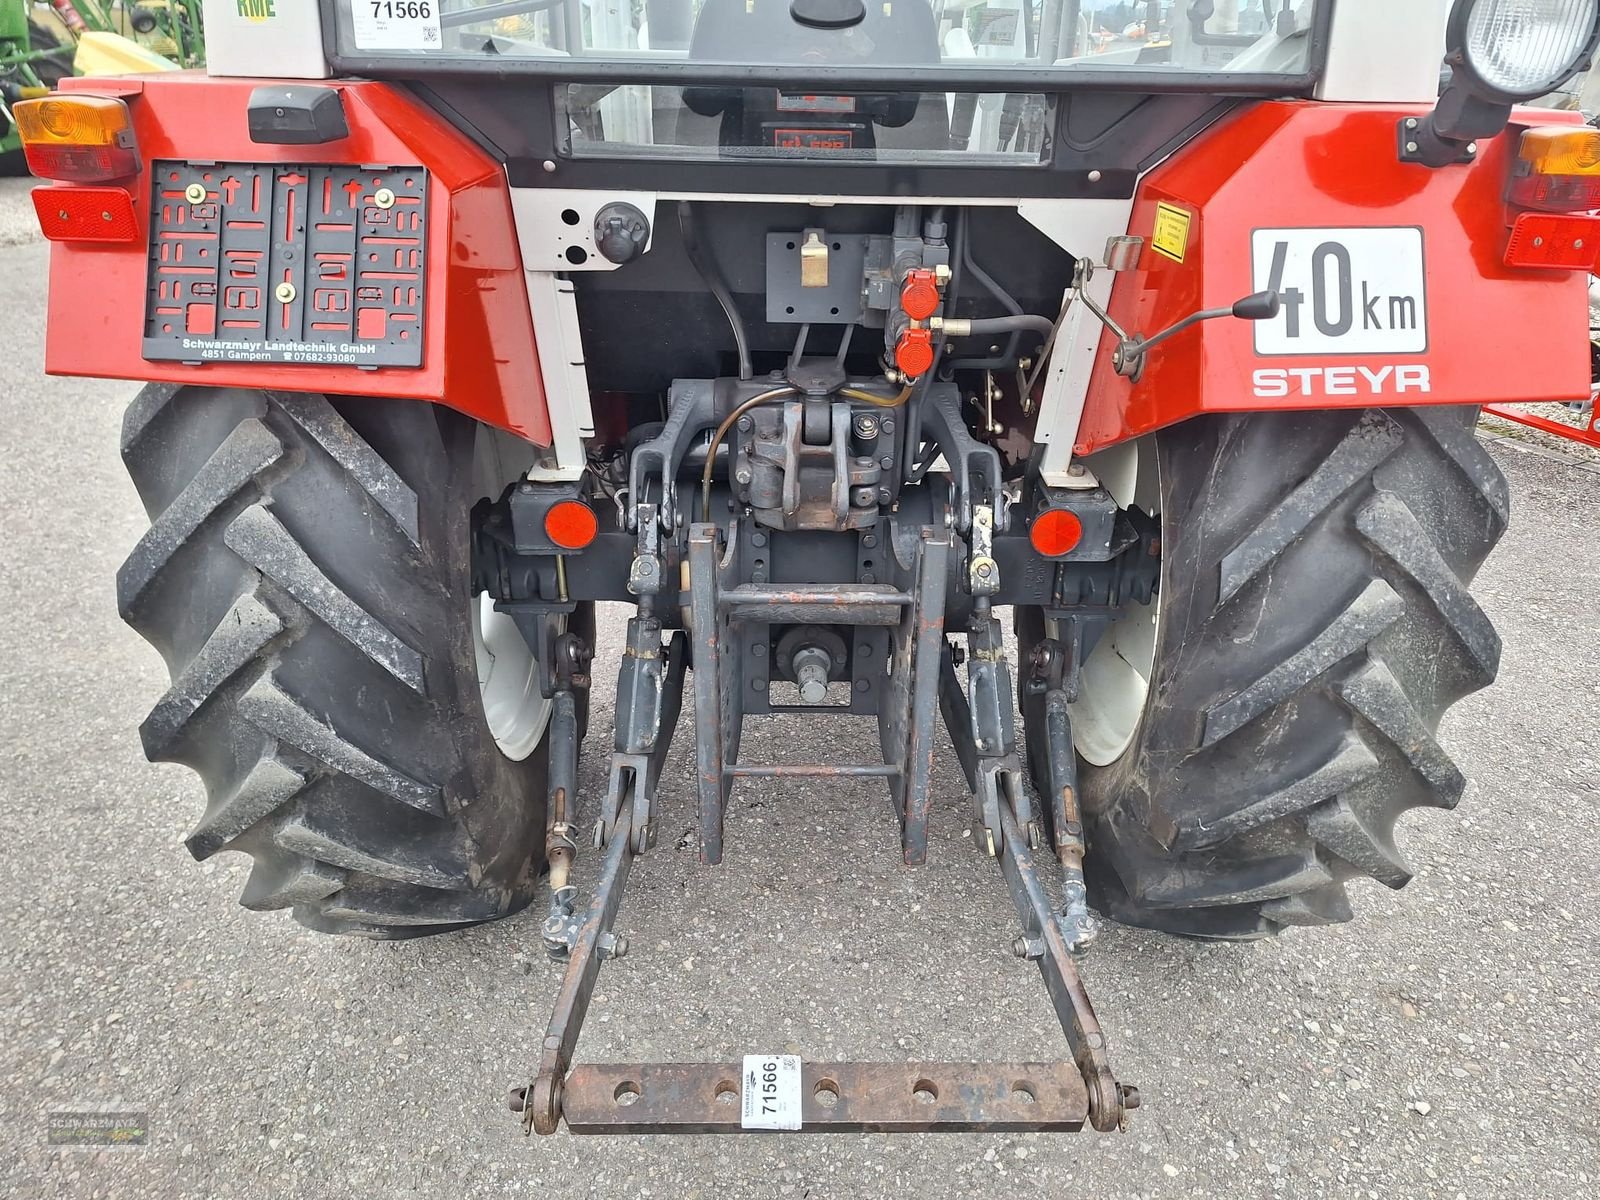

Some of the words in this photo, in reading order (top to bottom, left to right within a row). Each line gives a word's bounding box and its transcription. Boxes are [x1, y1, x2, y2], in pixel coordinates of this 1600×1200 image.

[370, 1, 431, 19] 71566
[1267, 241, 1353, 337] 40
[1362, 280, 1417, 330] km
[182, 339, 262, 352] Schwarzmayr
[264, 341, 337, 353] Landtechnik
[340, 343, 376, 354] GmbH
[201, 350, 224, 359] 4851
[227, 350, 272, 361] Gampern
[294, 352, 356, 362] 07682-93080
[1252, 364, 1431, 396] STEYR
[762, 1062, 777, 1115] 71566
